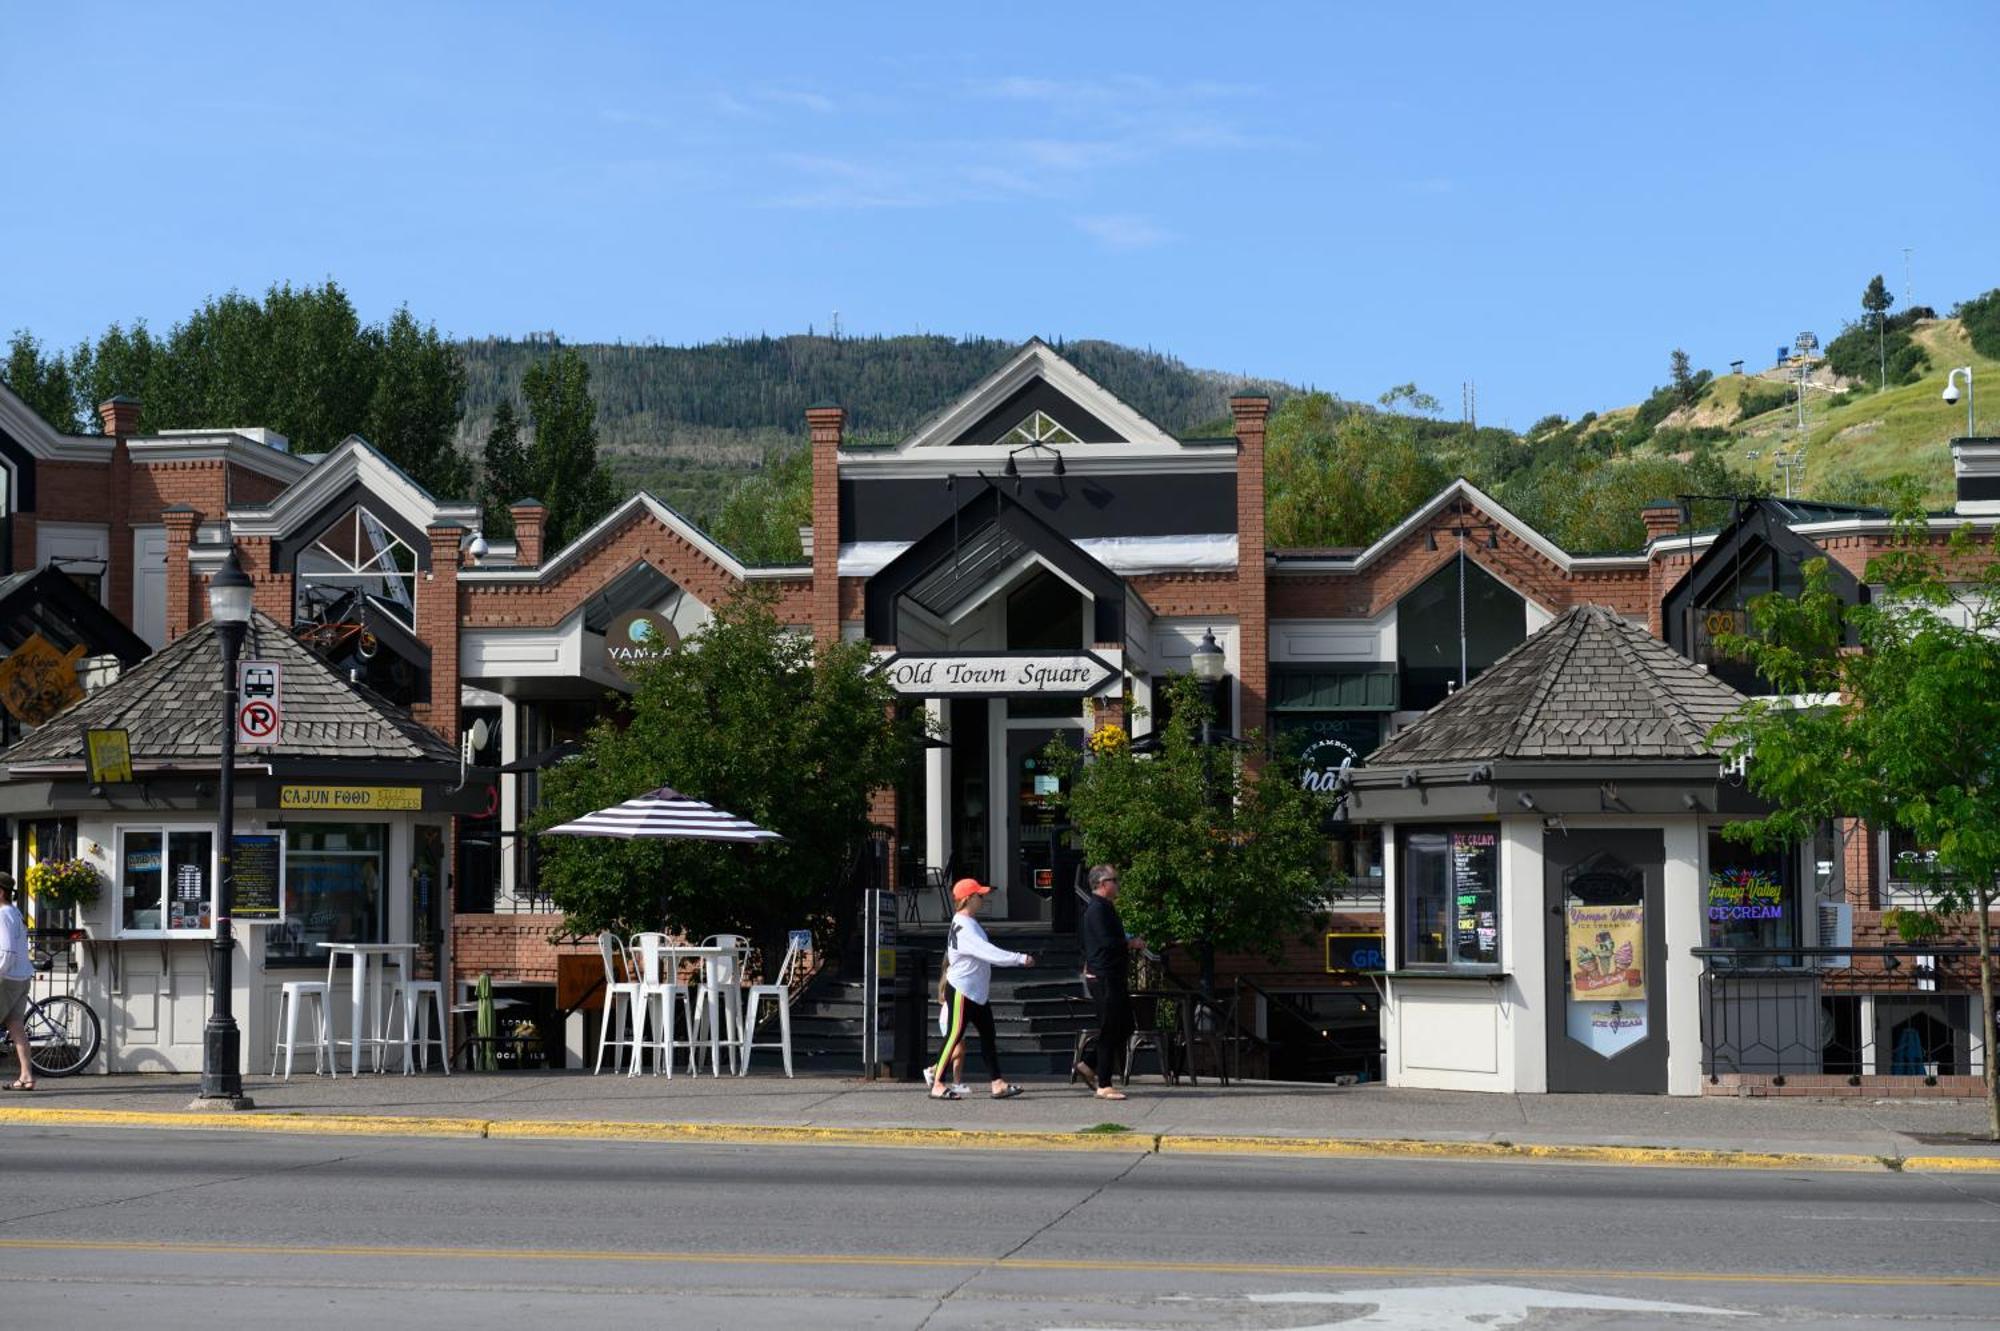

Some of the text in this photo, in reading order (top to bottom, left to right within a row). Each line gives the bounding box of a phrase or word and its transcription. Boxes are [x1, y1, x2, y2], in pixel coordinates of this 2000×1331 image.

[896, 662, 1091, 690] Old Town Square
[283, 789, 371, 804] CAJUN FOOD
[1745, 879, 1783, 905] Valley
[1708, 906, 1782, 920] CE CREAM
